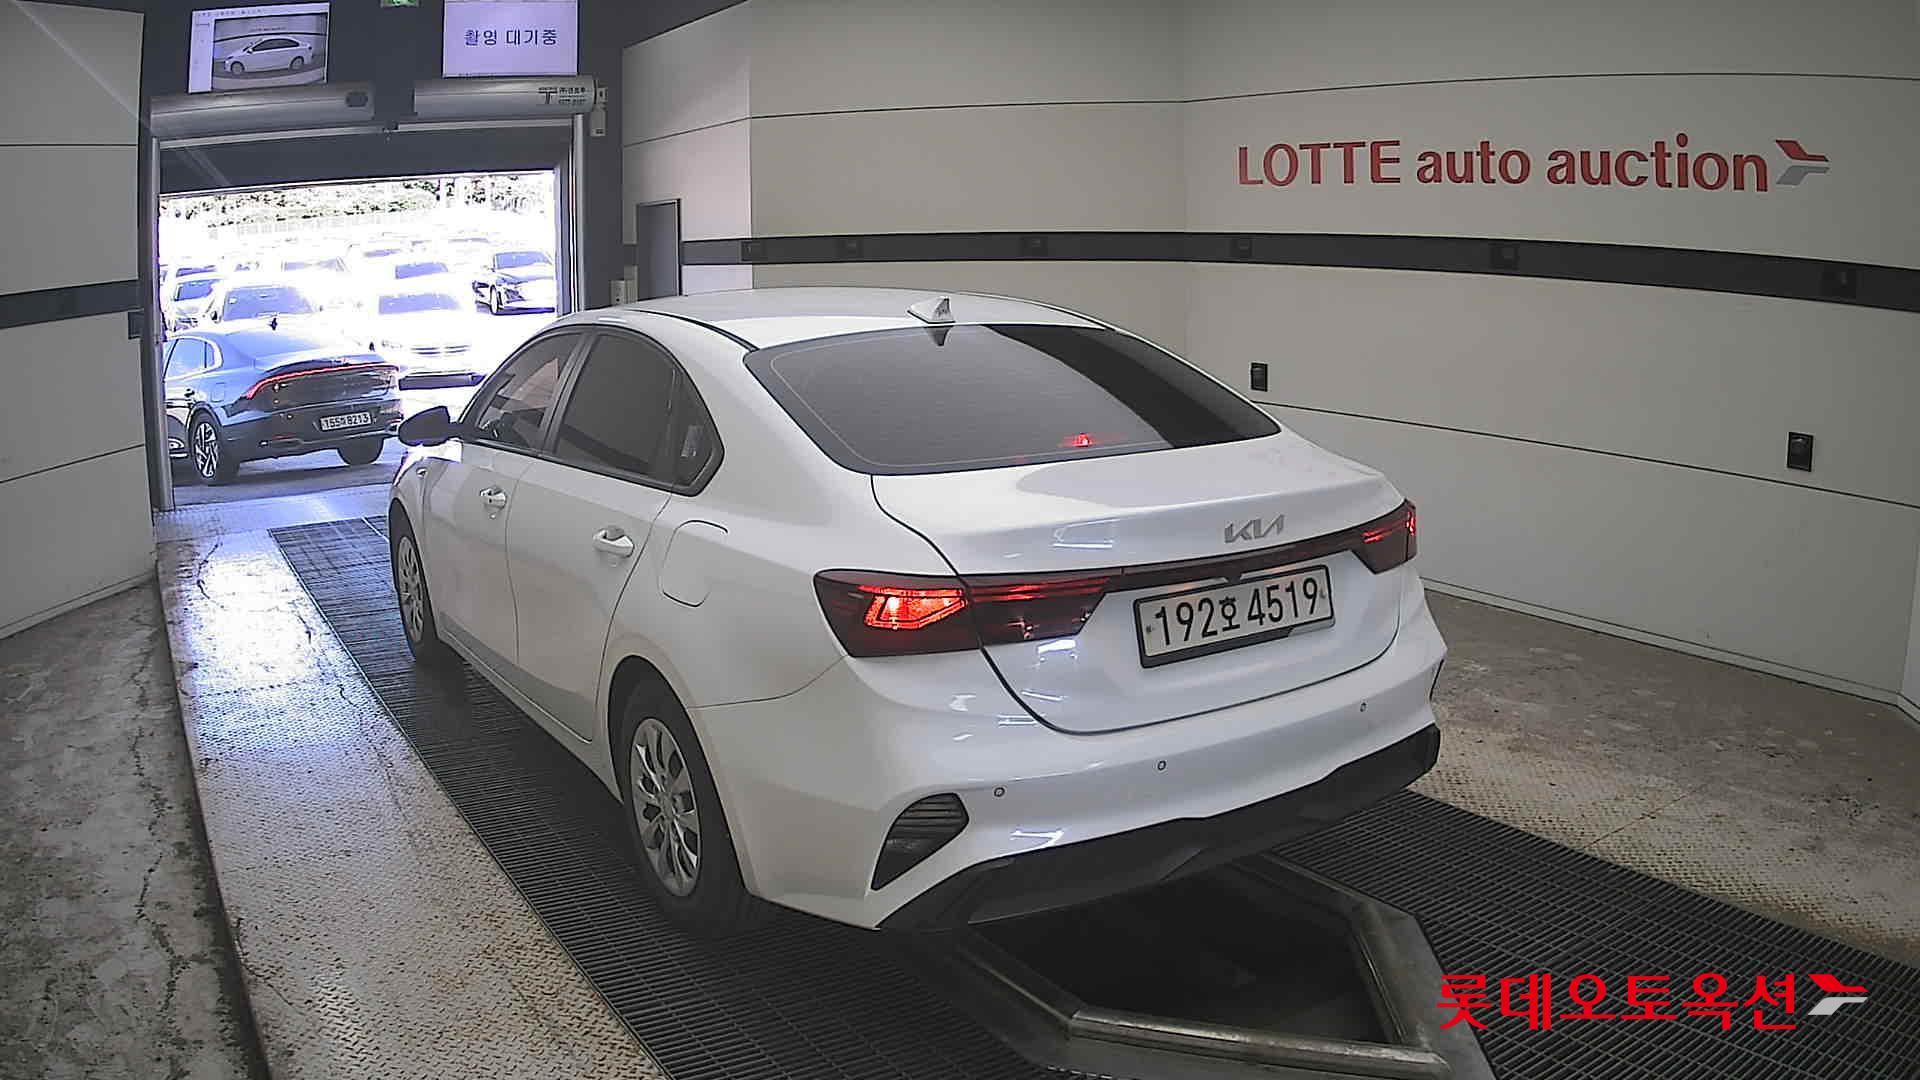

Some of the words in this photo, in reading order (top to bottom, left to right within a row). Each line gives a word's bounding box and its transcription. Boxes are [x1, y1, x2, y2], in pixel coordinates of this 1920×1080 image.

[464, 29, 498, 46] 촬영
[506, 28, 558, 46] 대기중
[1238, 140, 1400, 186] LOTTE
[1418, 140, 1531, 185] auto
[1548, 133, 1769, 192] auction
[1155, 597, 1240, 645] 192호
[1248, 577, 1318, 625] 4519
